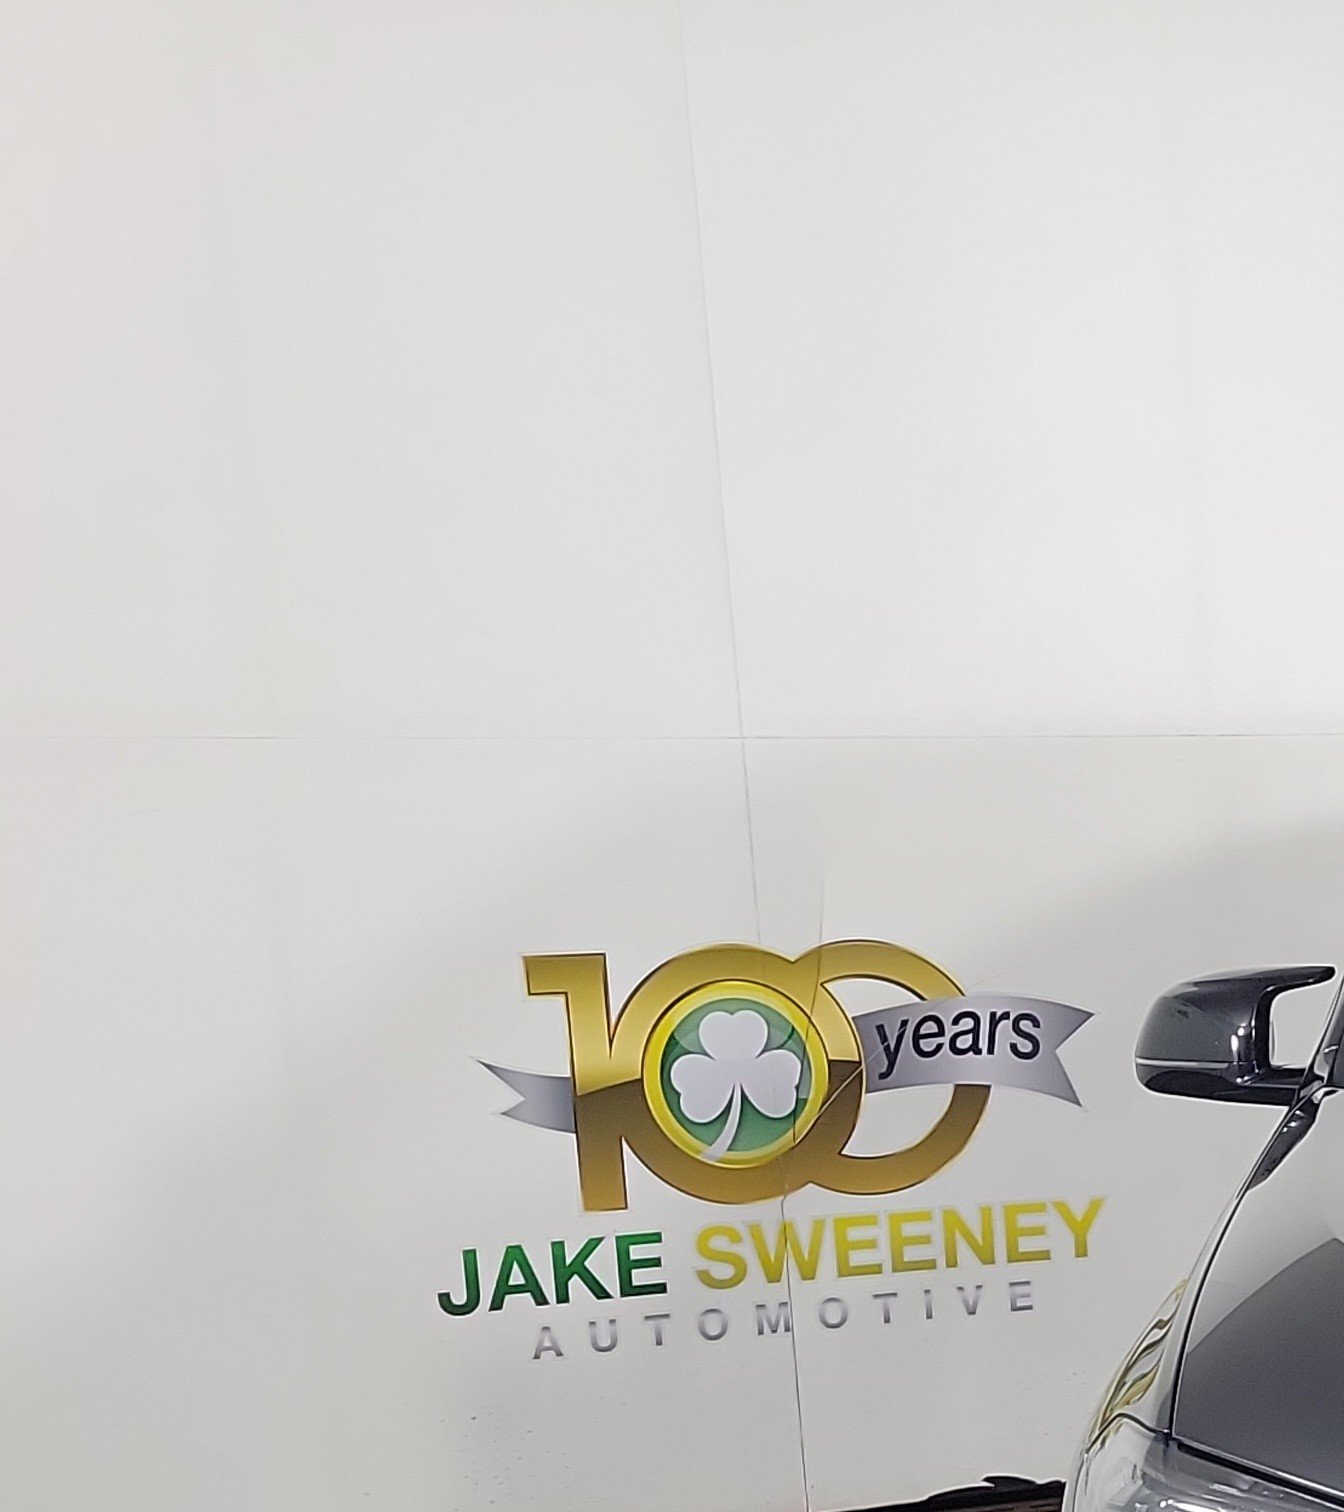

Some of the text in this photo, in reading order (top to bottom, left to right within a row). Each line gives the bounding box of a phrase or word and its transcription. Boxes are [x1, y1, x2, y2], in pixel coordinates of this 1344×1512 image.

[521, 939, 1043, 1213] 100 years
[437, 1198, 1106, 1317] JAKE SWEENEY
[532, 1280, 1035, 1360] AUTOMOTIVE
